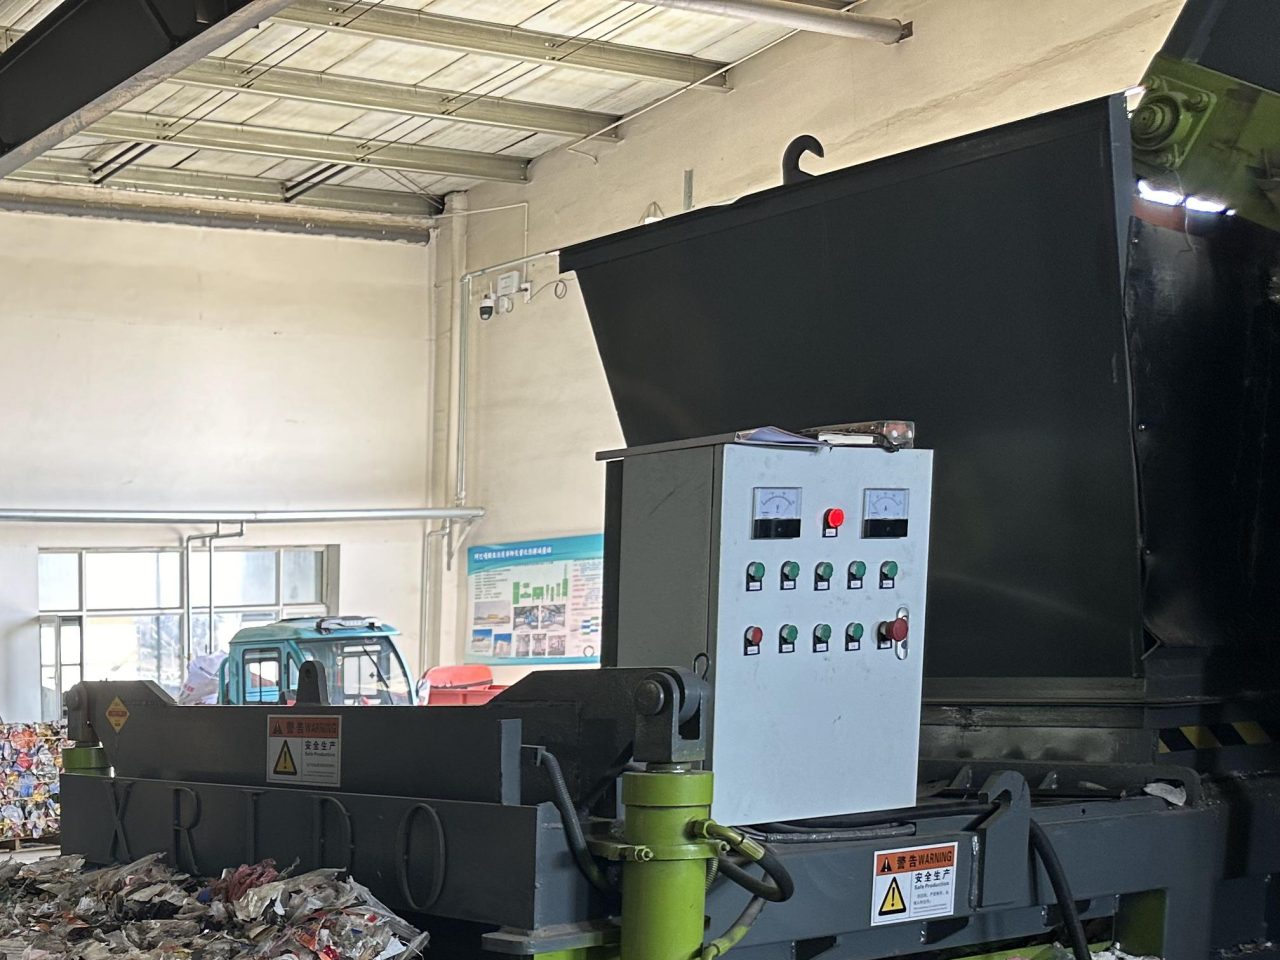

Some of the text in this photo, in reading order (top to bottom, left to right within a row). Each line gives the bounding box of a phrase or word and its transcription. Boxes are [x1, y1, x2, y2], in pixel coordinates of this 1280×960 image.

[287, 721, 337, 734] 警告 WARNING
[304, 740, 337, 751] 安全生产
[897, 851, 952, 869] 警告 WARNING
[915, 869, 950, 883] 安全生产
